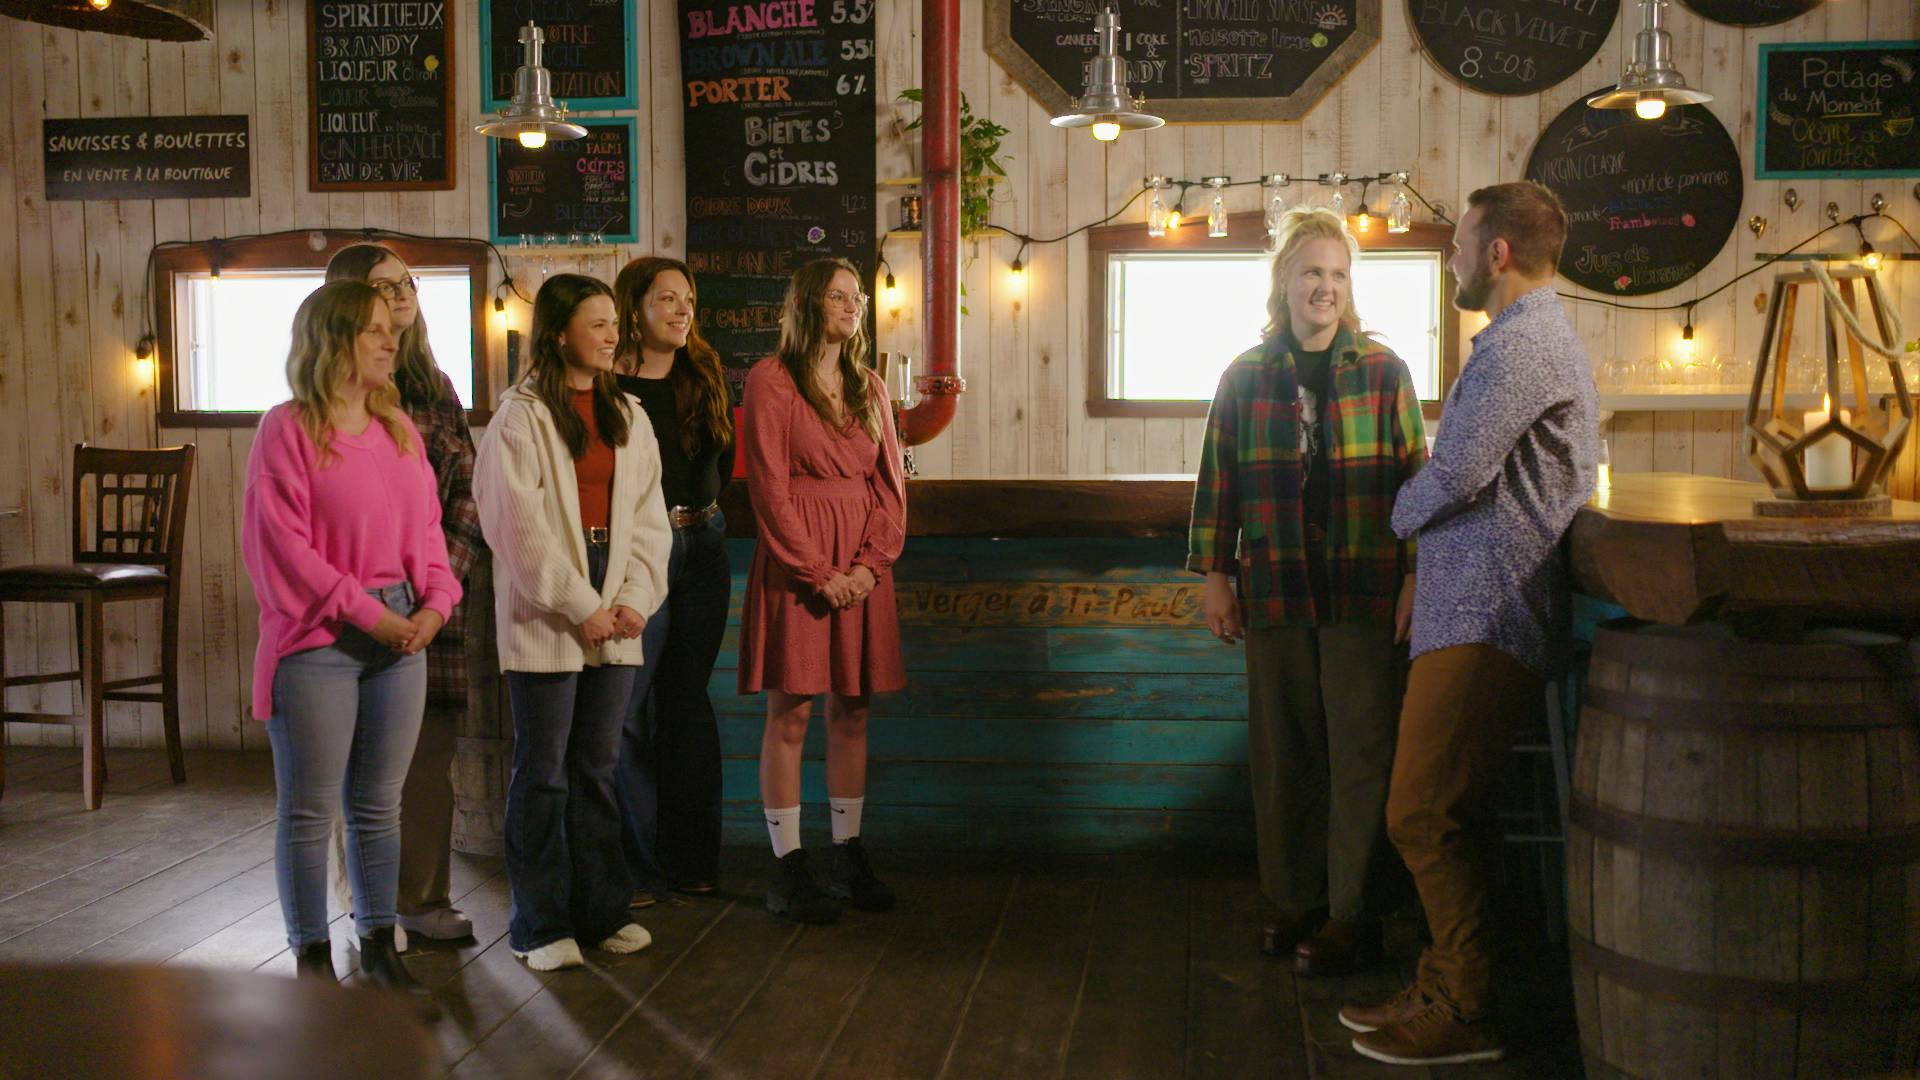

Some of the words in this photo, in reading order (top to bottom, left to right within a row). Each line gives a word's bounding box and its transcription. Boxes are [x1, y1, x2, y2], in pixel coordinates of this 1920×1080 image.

[322, 2, 444, 29] SPIRITUEUX
[687, 0, 817, 39] BLANCHE
[1419, 2, 1505, 36] BLACK
[1514, 11, 1598, 50] VELVET
[320, 33, 419, 58] BRANDY
[1136, 32, 1169, 46] COKE
[318, 59, 398, 82] LIQUEUR
[1189, 52, 1274, 80] SPRITZ
[687, 75, 793, 108] PORTER
[1802, 57, 1894, 105] Potage
[1778, 88, 1798, 103] du
[1806, 89, 1884, 114] Moment
[49, 134, 131, 152] SAUCISSES
[136, 132, 149, 151] &
[153, 131, 247, 150] BOULETTES
[769, 148, 785, 161] et
[63, 168, 82, 183] EN
[86, 167, 130, 182] VENTE
[147, 167, 160, 181] LA
[164, 166, 233, 182] BOUTIQUE
[358, 161, 384, 182] DE
[1575, 244, 1622, 278] Jus
[914, 583, 1013, 622] Verger
[1063, 585, 1191, 620] Ti-Paul
